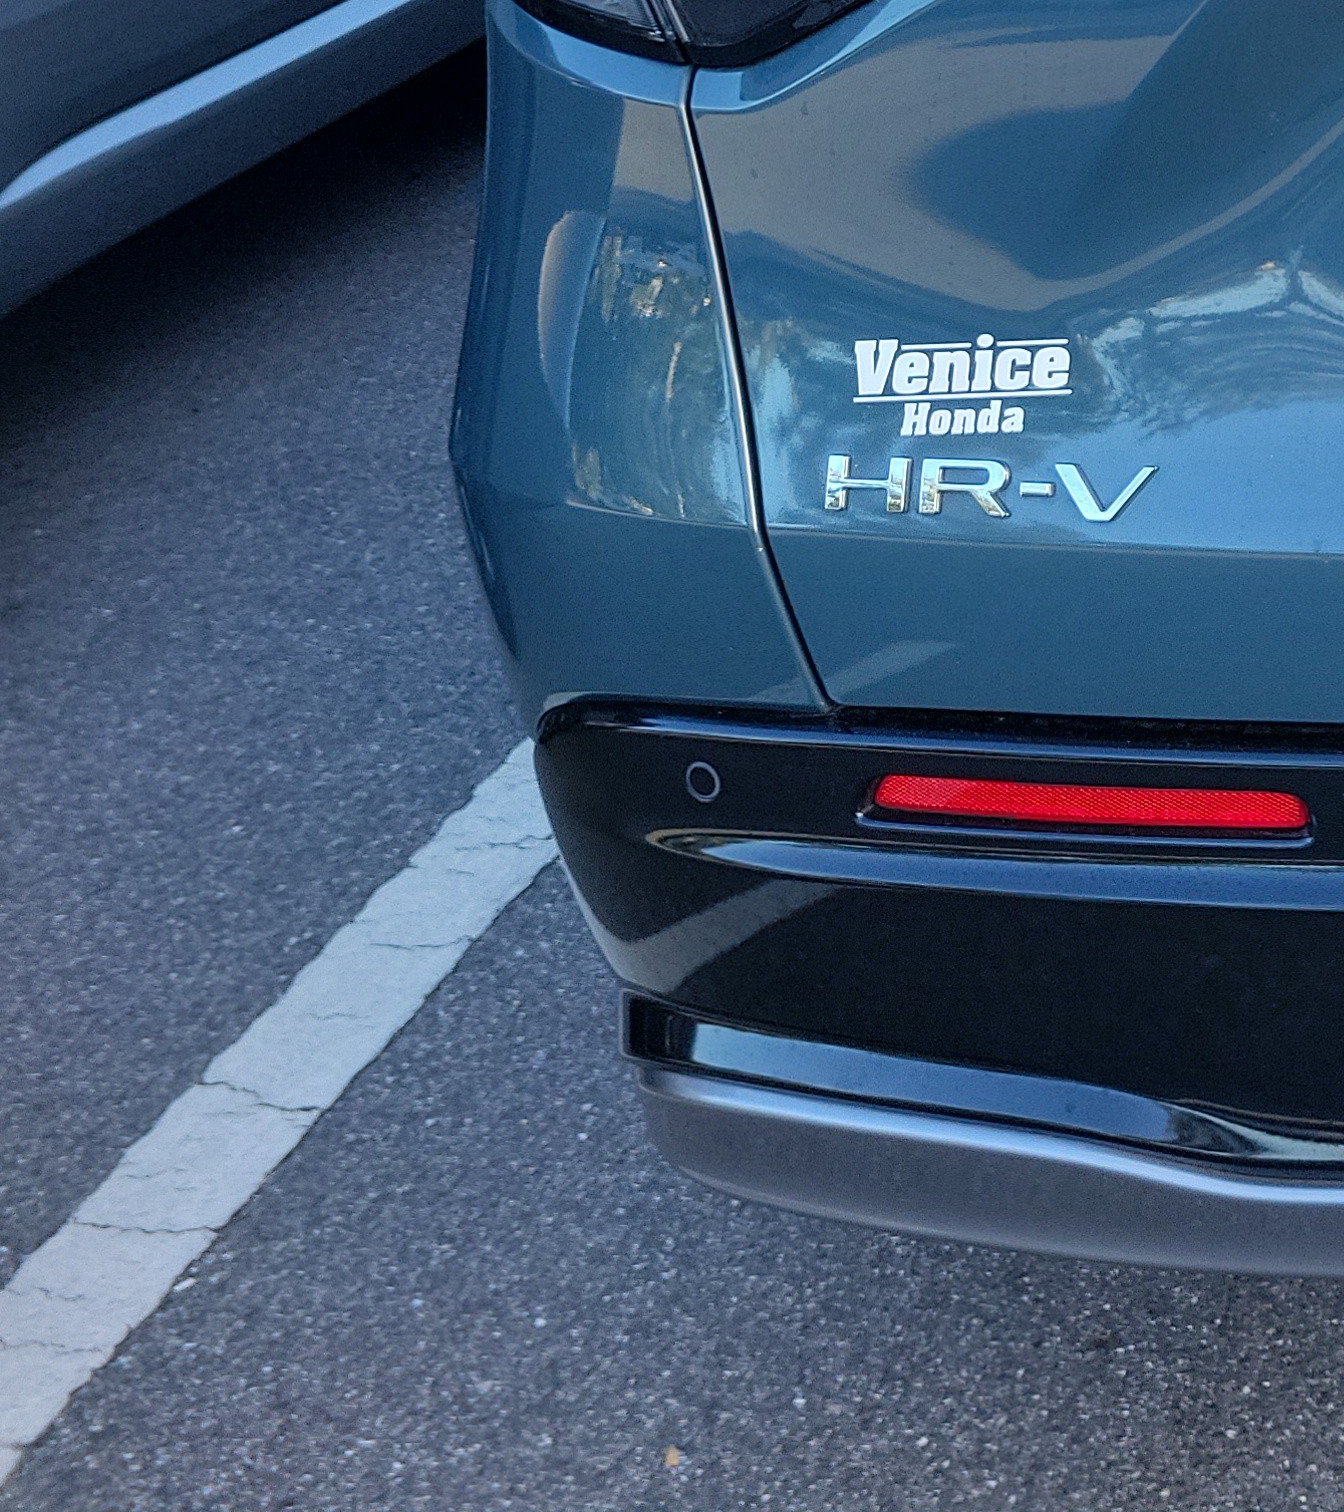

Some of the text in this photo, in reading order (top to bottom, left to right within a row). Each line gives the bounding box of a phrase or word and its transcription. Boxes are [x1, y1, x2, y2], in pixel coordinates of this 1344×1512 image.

[854, 333, 1071, 396] Venice
[900, 400, 1025, 437] Honda
[824, 454, 1160, 523] HR-V
